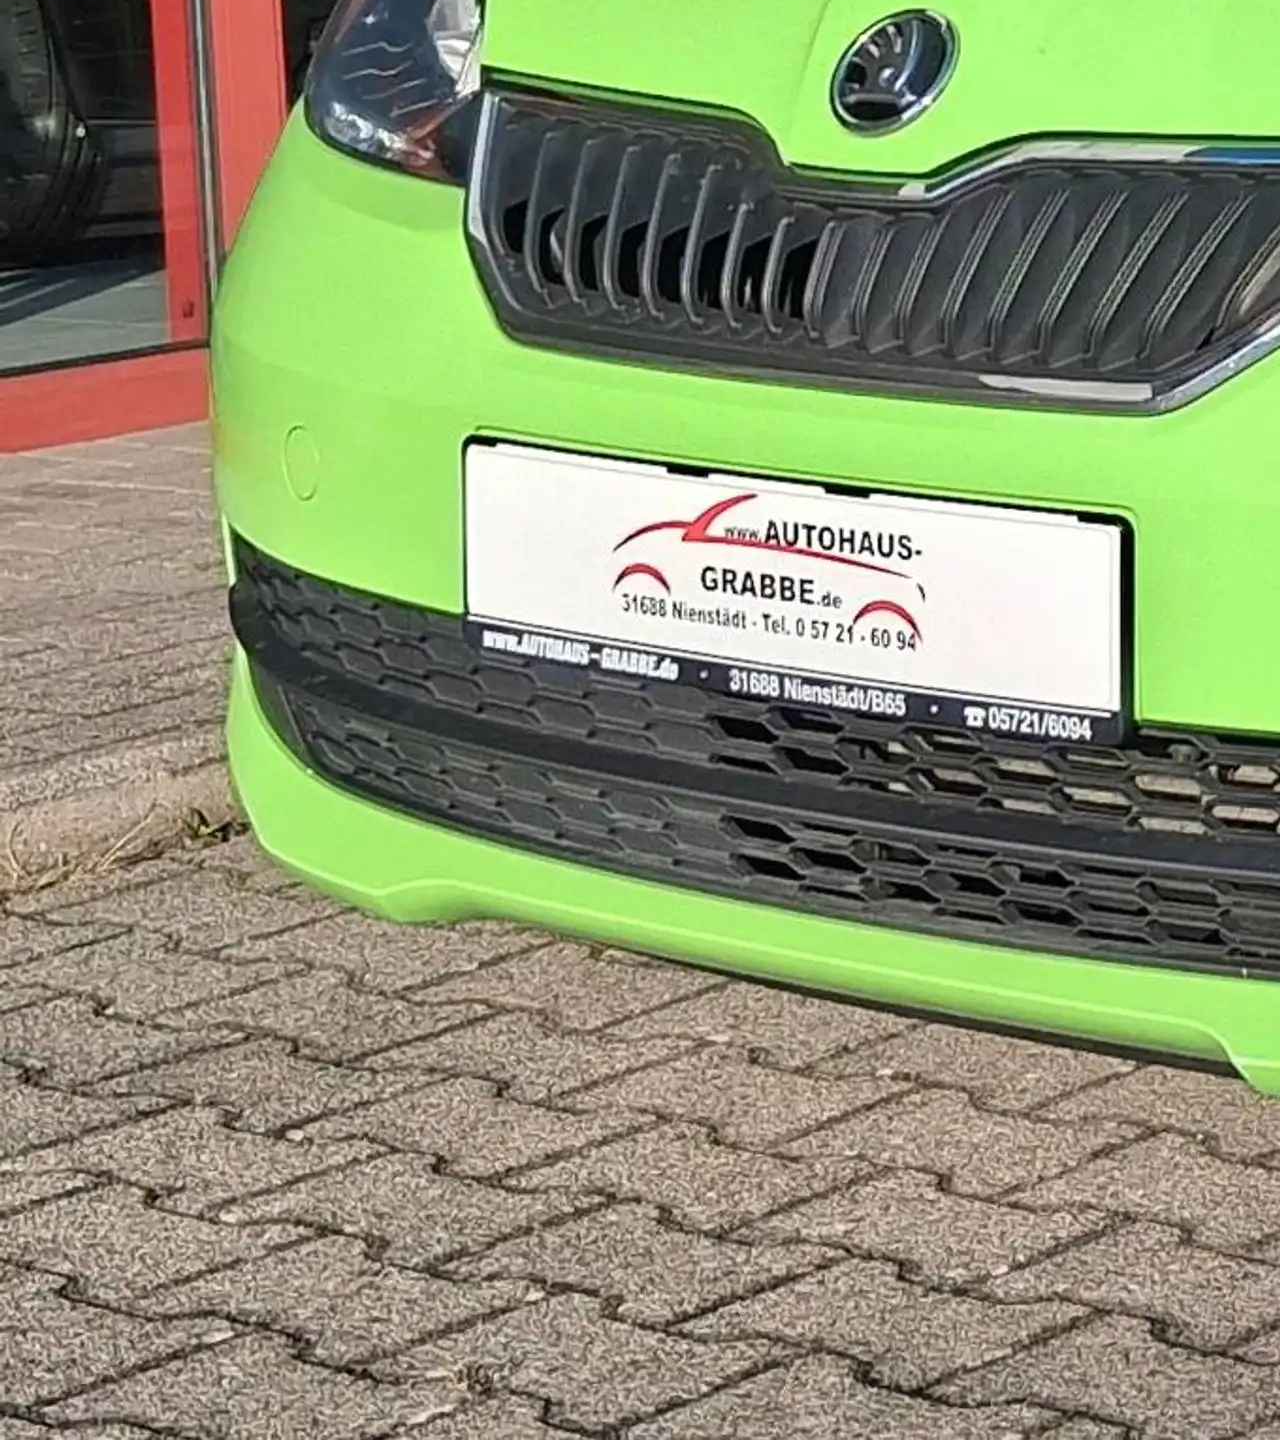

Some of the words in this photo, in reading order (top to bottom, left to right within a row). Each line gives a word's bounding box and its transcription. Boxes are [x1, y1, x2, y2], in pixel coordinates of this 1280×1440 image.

[700, 565, 842, 610] GRABBE.de
[672, 601, 747, 630] Nienstädt
[762, 614, 791, 636] Tel.
